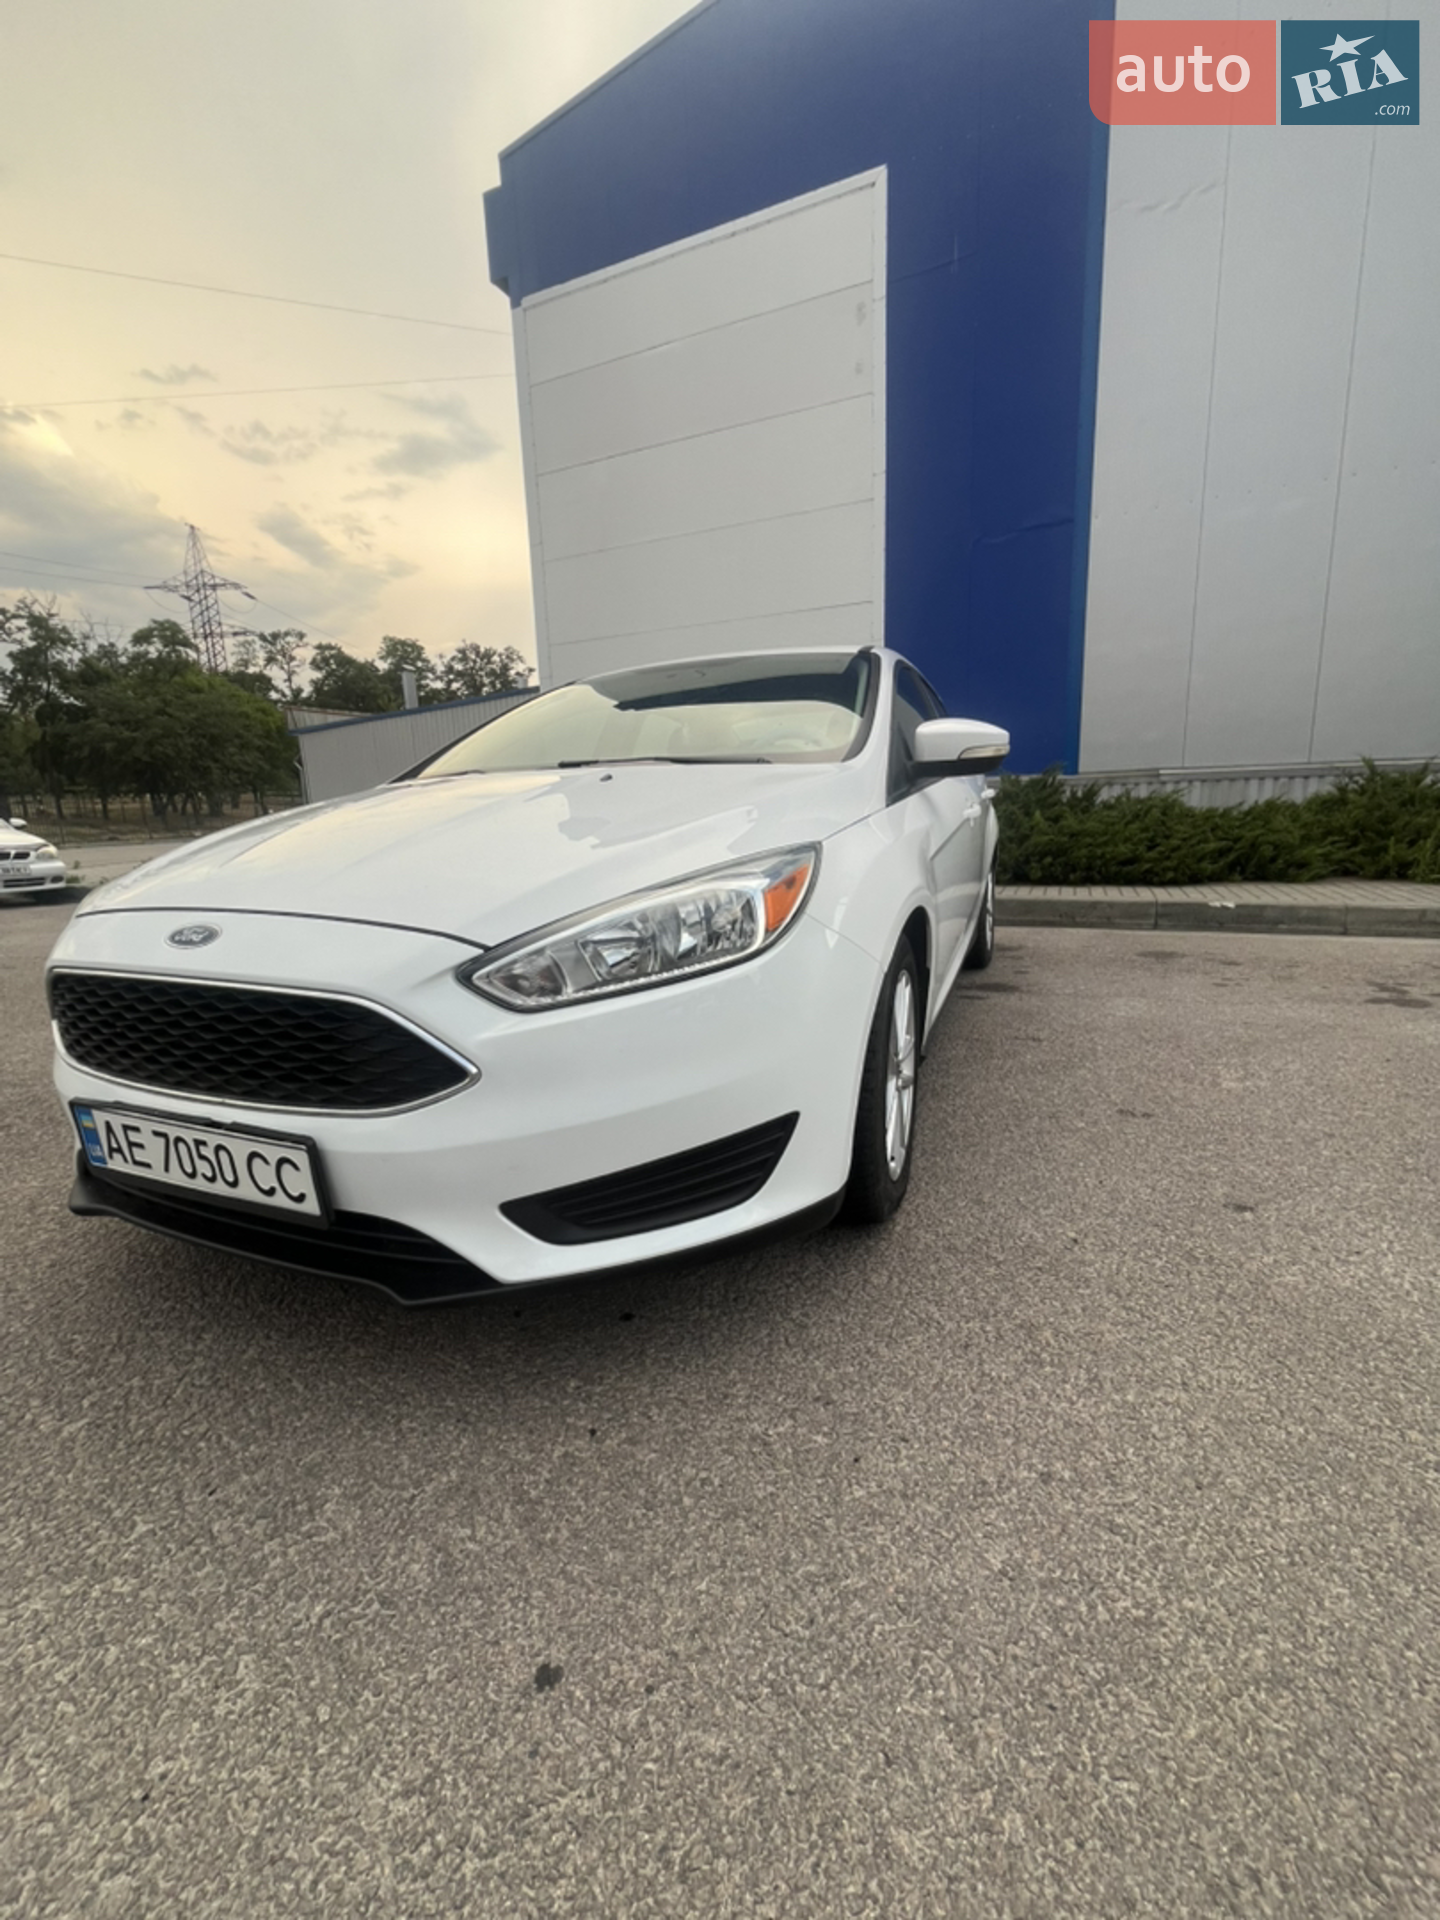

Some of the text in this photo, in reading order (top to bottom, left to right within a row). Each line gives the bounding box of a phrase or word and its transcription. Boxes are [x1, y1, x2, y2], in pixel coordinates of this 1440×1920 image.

[104, 1119, 307, 1204] AE 7050 CC
